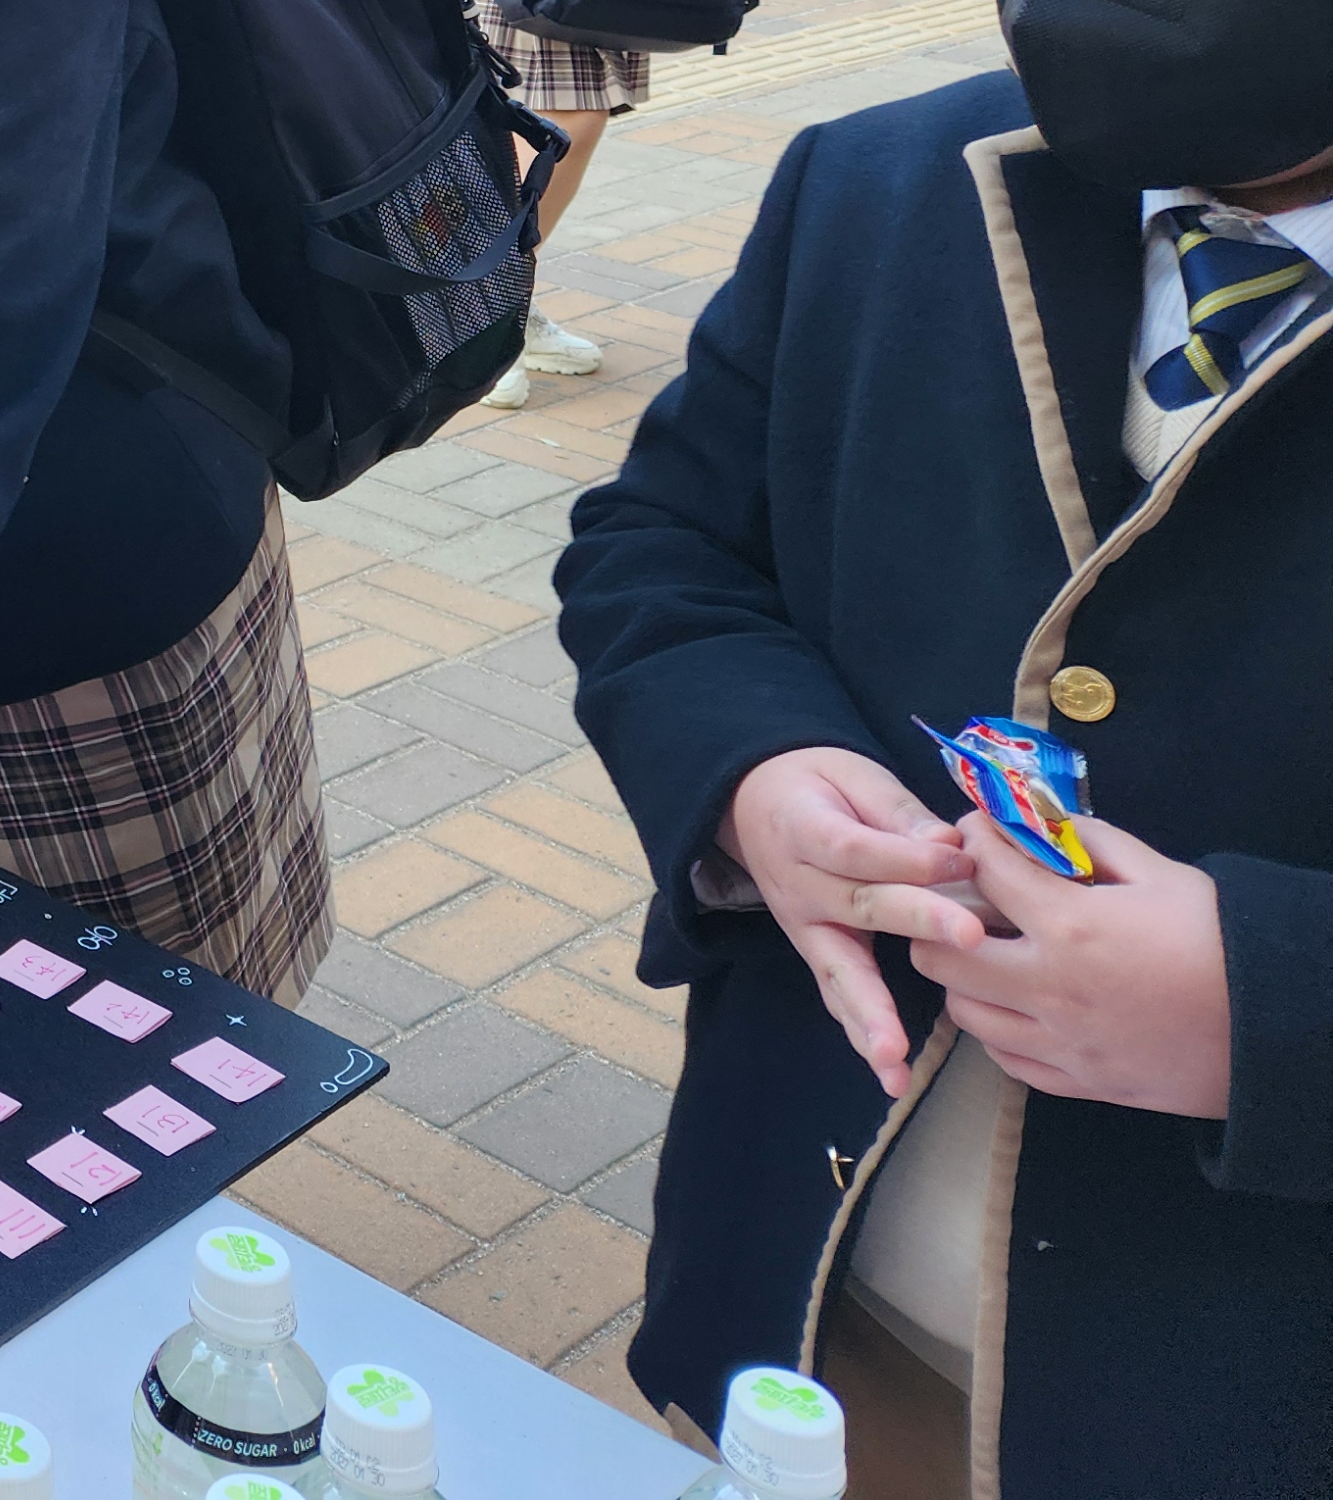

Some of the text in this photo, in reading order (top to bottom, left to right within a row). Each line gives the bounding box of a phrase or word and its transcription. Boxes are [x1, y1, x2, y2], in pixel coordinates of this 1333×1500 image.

[21, 955, 67, 981] 143
[218, 1059, 266, 1087] 141
[70, 1152, 122, 1186] 121
[198, 1429, 232, 1451] ZERO
[234, 1441, 277, 1457] SUGAR
